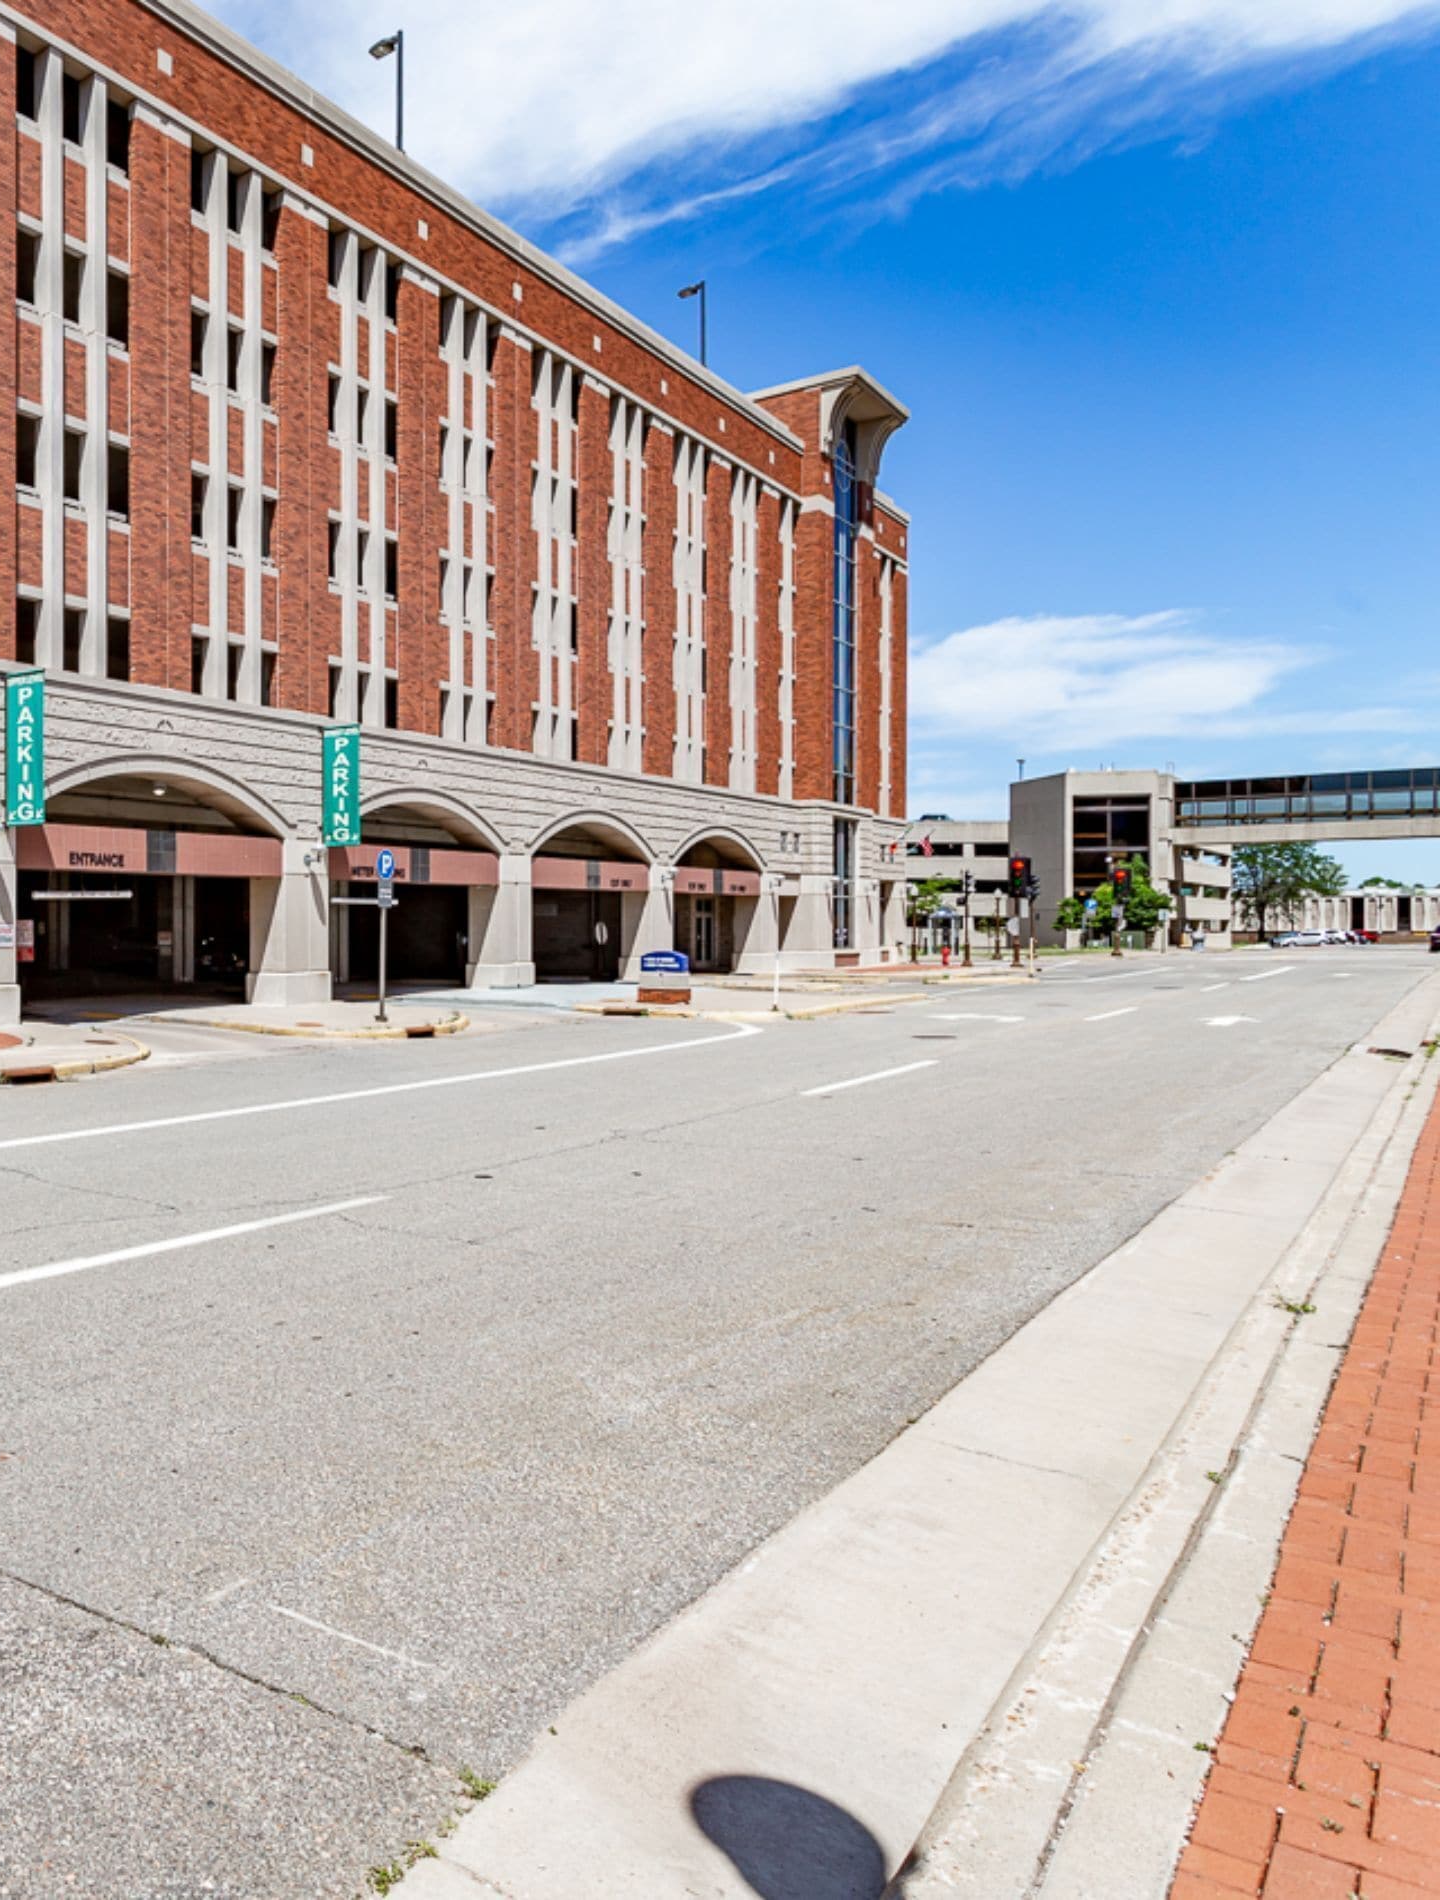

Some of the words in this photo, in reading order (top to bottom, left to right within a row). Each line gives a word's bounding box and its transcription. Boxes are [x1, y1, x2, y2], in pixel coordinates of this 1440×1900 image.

[17, 687, 34, 820] PARKING
[333, 737, 350, 842] PARKING
[69, 852, 124, 867] ENTRANCE
